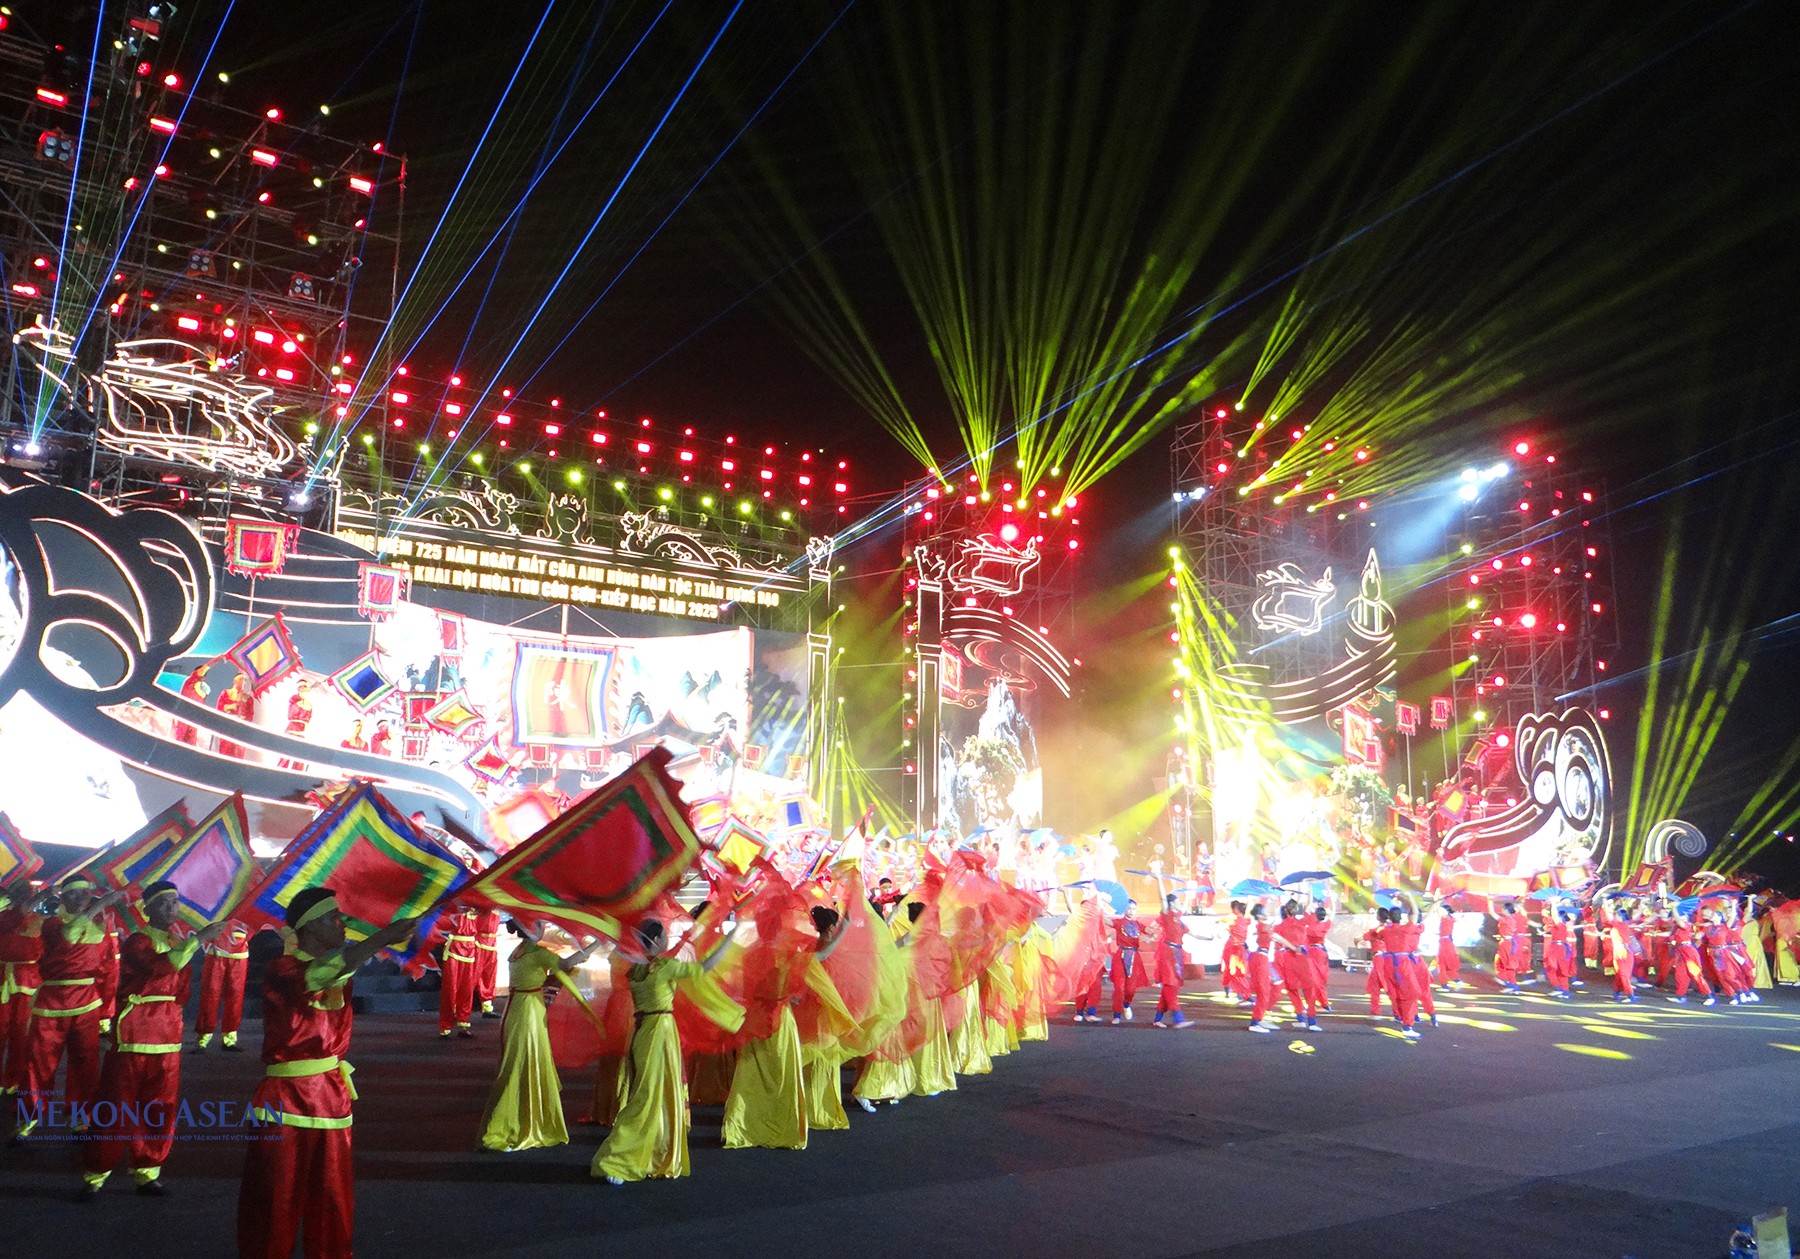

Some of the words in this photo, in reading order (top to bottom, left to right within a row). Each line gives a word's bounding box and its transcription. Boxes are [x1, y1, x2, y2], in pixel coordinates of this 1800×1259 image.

[414, 565, 450, 584] KHAI
[512, 577, 540, 595] THU
[658, 597, 686, 615] NĂM
[688, 602, 719, 619] 2025
[416, 542, 442, 560] 725
[445, 545, 478, 565] NĂM
[480, 551, 516, 570] NGÀY
[549, 559, 576, 578] CỦA
[578, 565, 605, 583] ANH
[669, 577, 693, 596] TỘC
